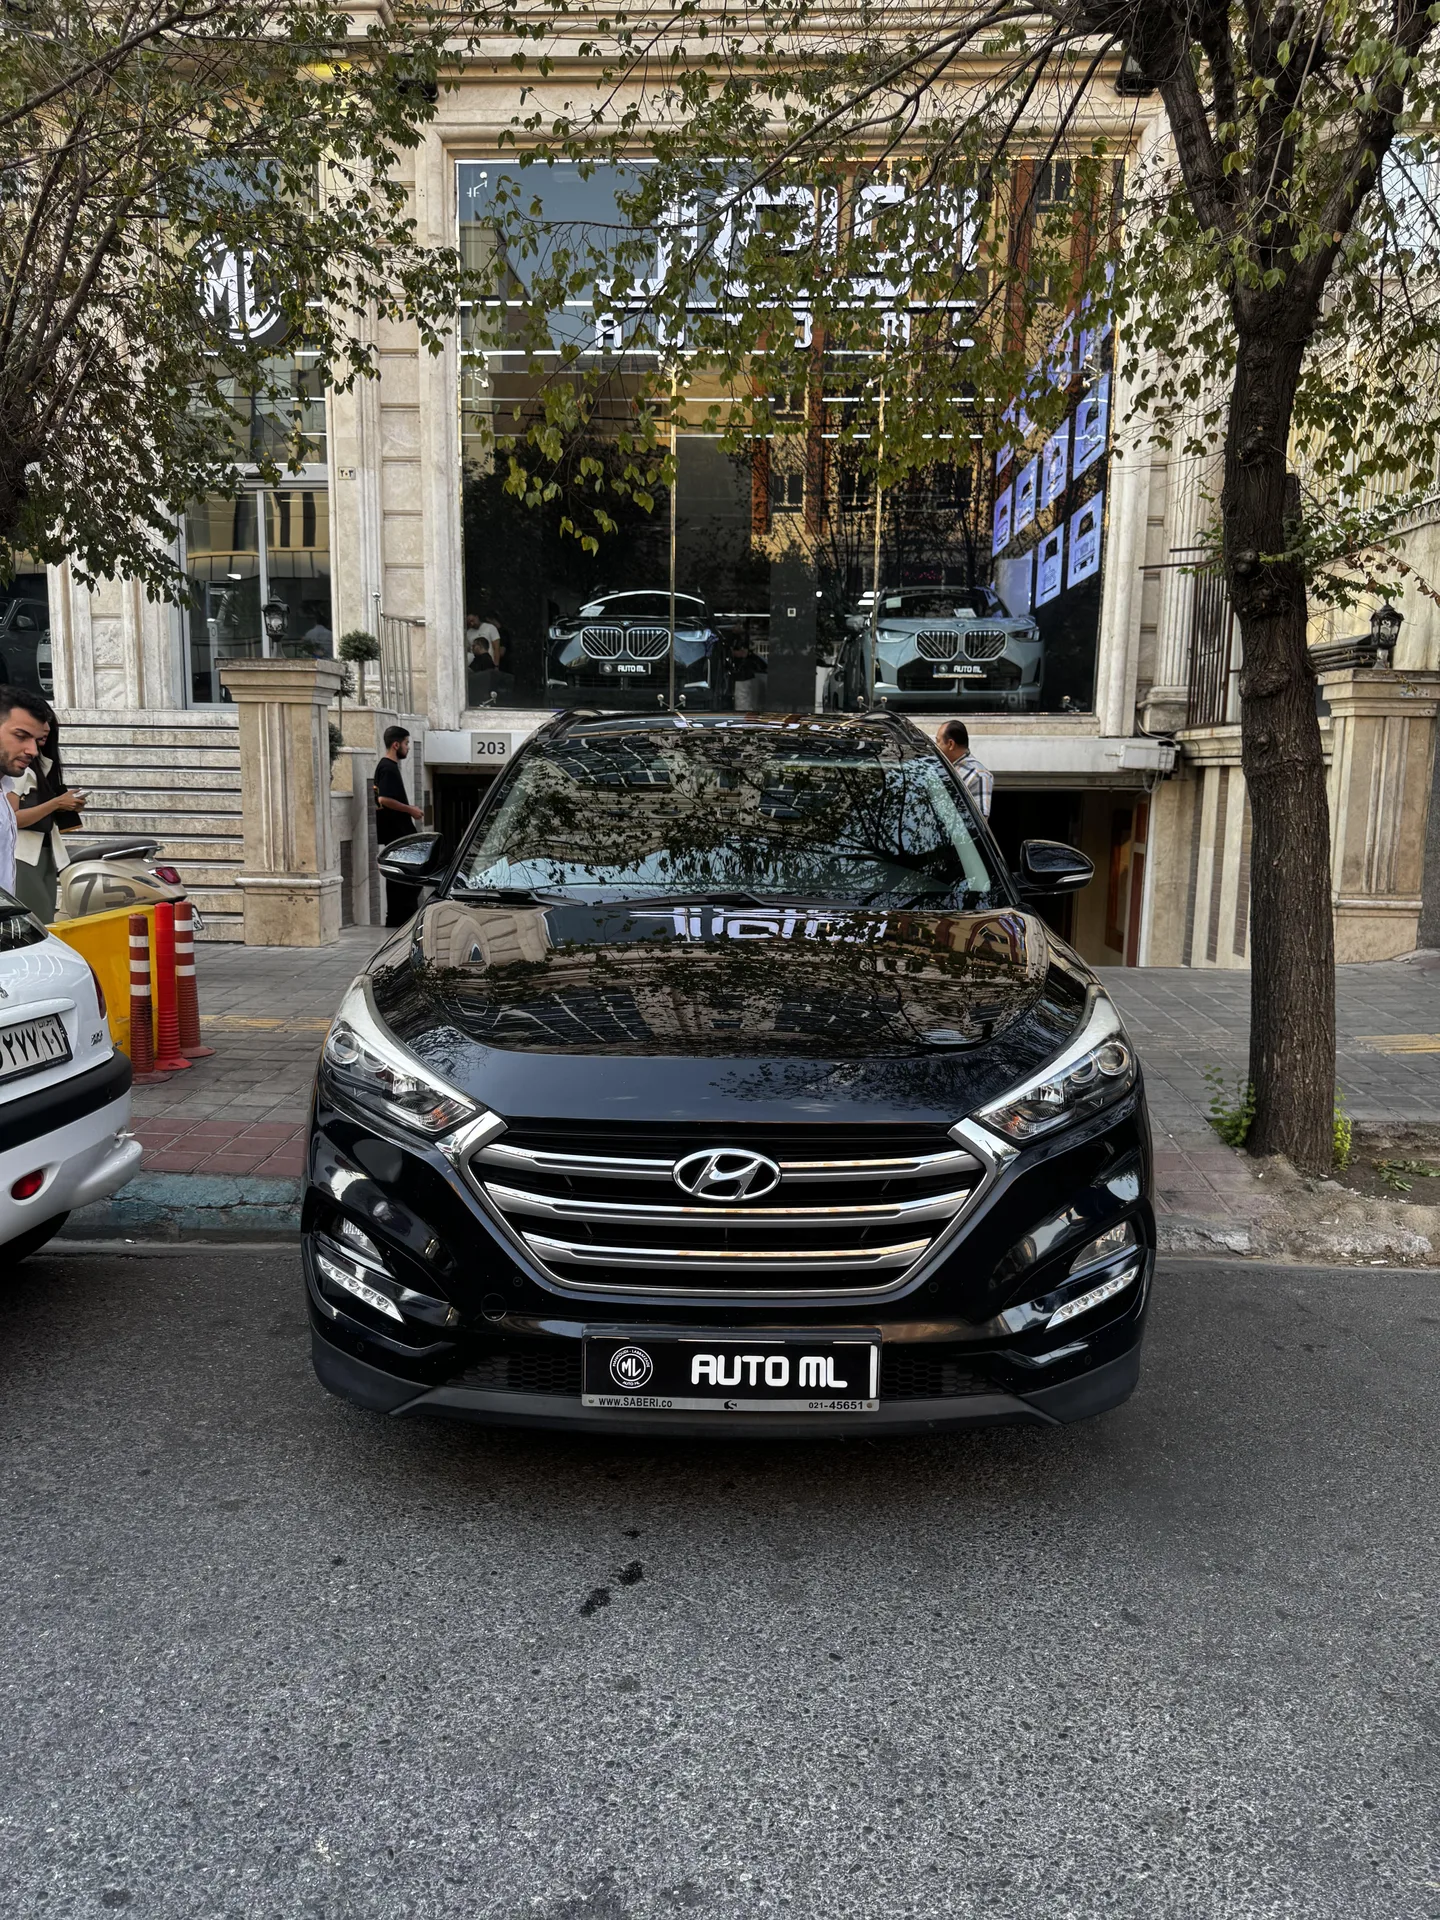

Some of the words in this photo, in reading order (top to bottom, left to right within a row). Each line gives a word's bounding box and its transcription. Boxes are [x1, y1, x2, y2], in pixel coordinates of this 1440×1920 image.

[617, 664, 636, 673] AUTO
[636, 664, 647, 673] ML
[953, 665, 972, 673] AUTO
[972, 665, 983, 673] ML
[476, 741, 506, 755] 203
[70, 872, 136, 917] 75
[621, 1358, 642, 1377] ML
[691, 1353, 790, 1388] AUTO
[799, 1355, 848, 1389] ML
[808, 1401, 863, 1410] 021-45651
